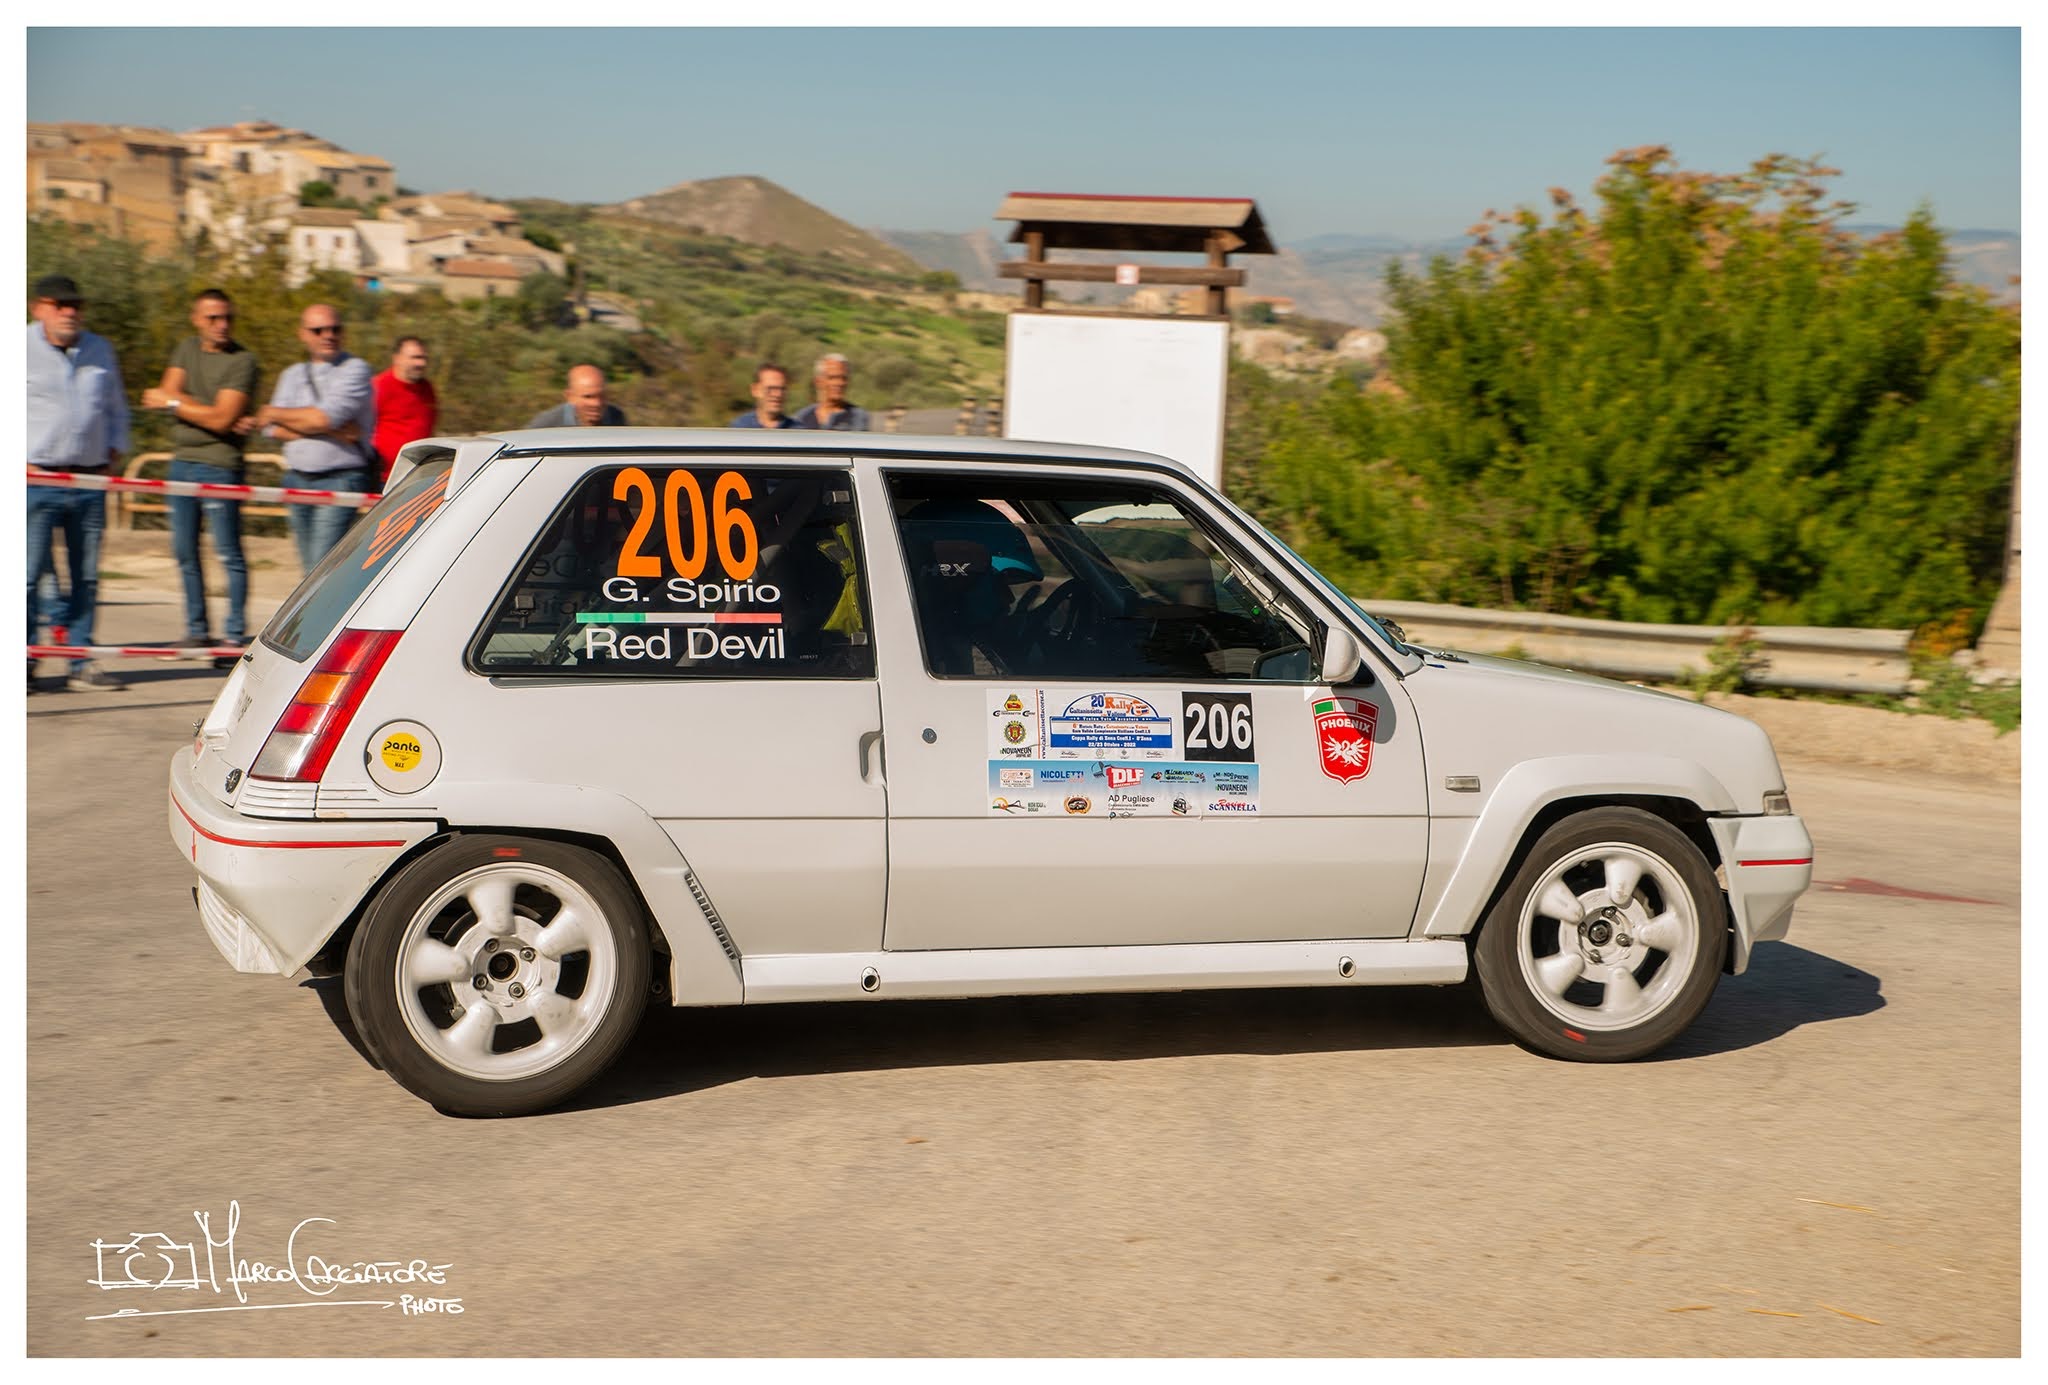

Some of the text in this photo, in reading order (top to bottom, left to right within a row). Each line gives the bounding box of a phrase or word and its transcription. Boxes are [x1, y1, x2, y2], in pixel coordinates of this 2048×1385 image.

[613, 467, 758, 581] 206
[602, 577, 781, 609] G. Spirio
[586, 628, 785, 659] Red Devil
[1104, 697, 1131, 713] Rally
[1185, 703, 1253, 750] 206
[1321, 718, 1371, 733] PHOENIX
[1040, 770, 1084, 778] NICOLETTI
[1111, 768, 1144, 784] DLF
[1122, 795, 1155, 804] Pugliese
[1208, 803, 1257, 811] SCANNELLA
